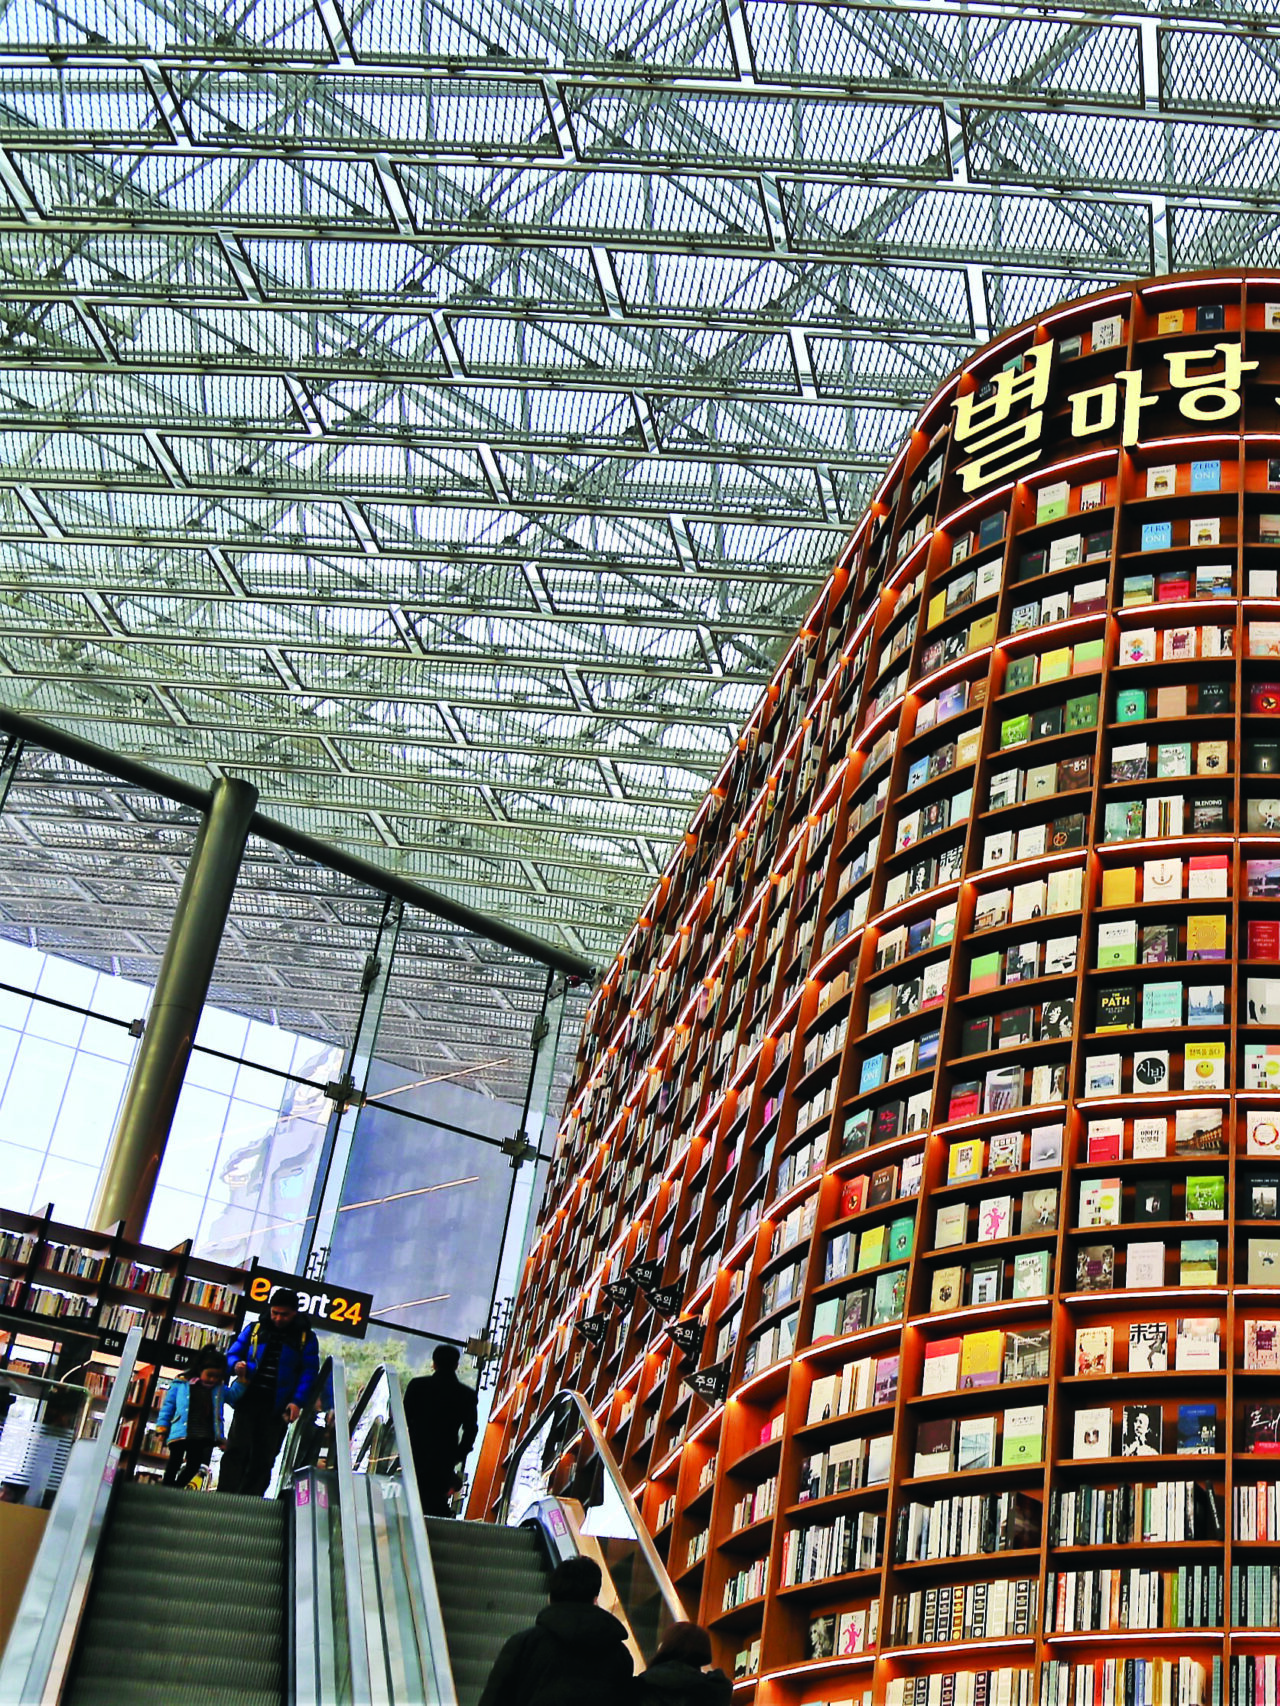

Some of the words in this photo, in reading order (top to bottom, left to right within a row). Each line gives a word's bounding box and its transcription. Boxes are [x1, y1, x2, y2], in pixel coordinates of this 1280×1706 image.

[1102, 996, 1131, 1008] PATH
[1138, 1060, 1165, 1084] 시밤
[635, 1267, 654, 1280] 주의
[610, 1284, 628, 1297] 주의
[654, 1293, 673, 1306] 주의
[583, 1321, 600, 1332] 주의
[674, 1326, 694, 1341] 주의
[695, 1374, 717, 1389] 주의
